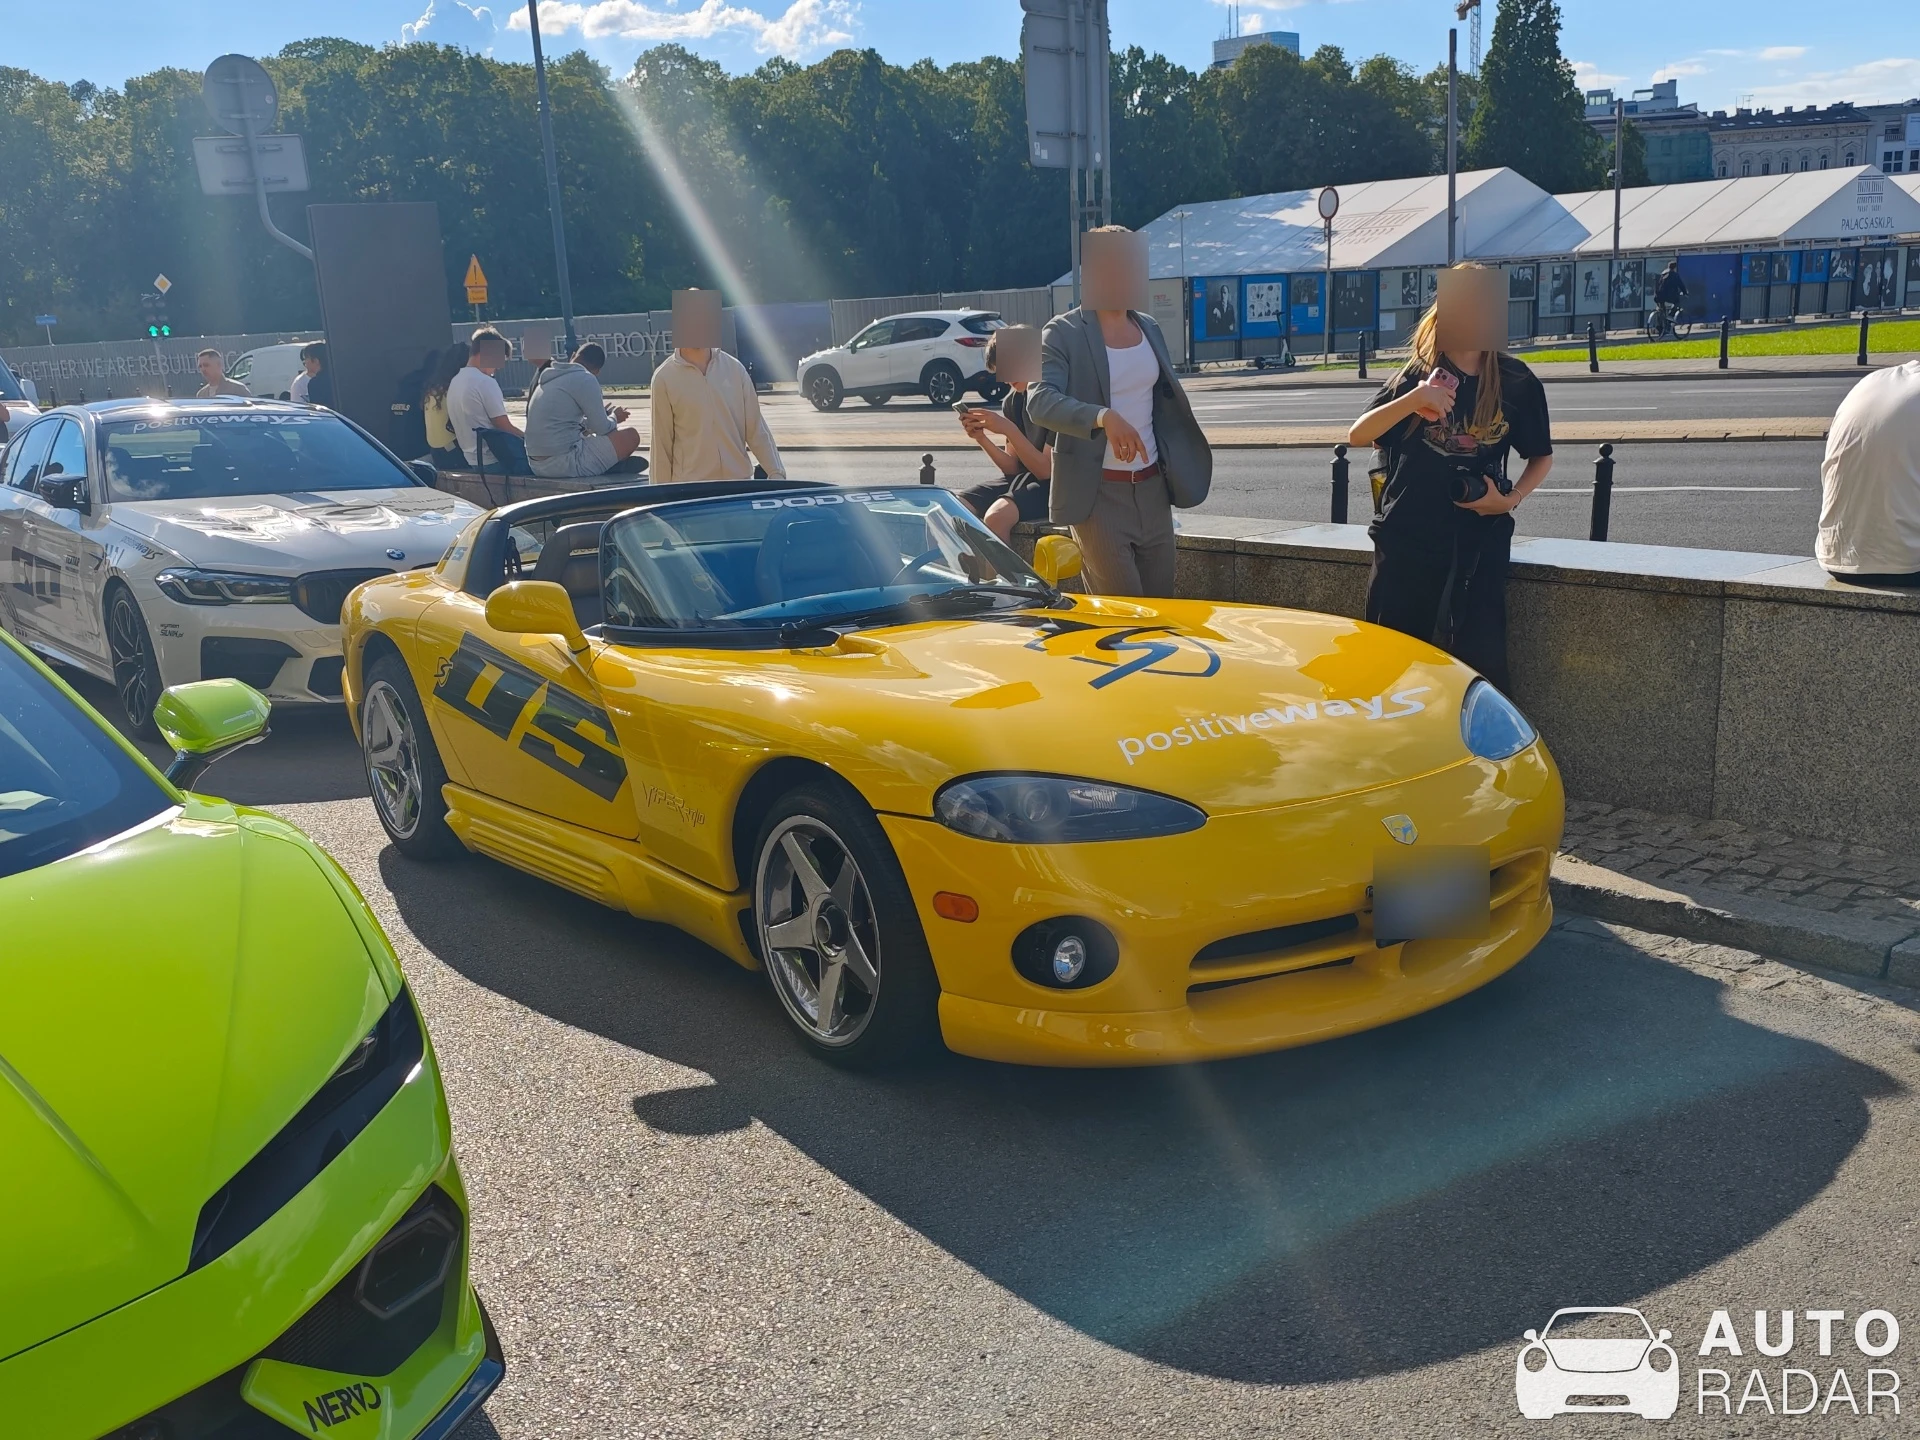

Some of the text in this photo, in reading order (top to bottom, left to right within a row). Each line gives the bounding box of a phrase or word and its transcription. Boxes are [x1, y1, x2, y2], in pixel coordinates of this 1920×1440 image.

[9, 359, 79, 381] OGETHER
[80, 358, 105, 377] WE
[108, 355, 138, 377] ARE
[133, 414, 322, 434] positiveways
[752, 491, 895, 509] DODGE
[1117, 686, 1431, 765] positiveways
